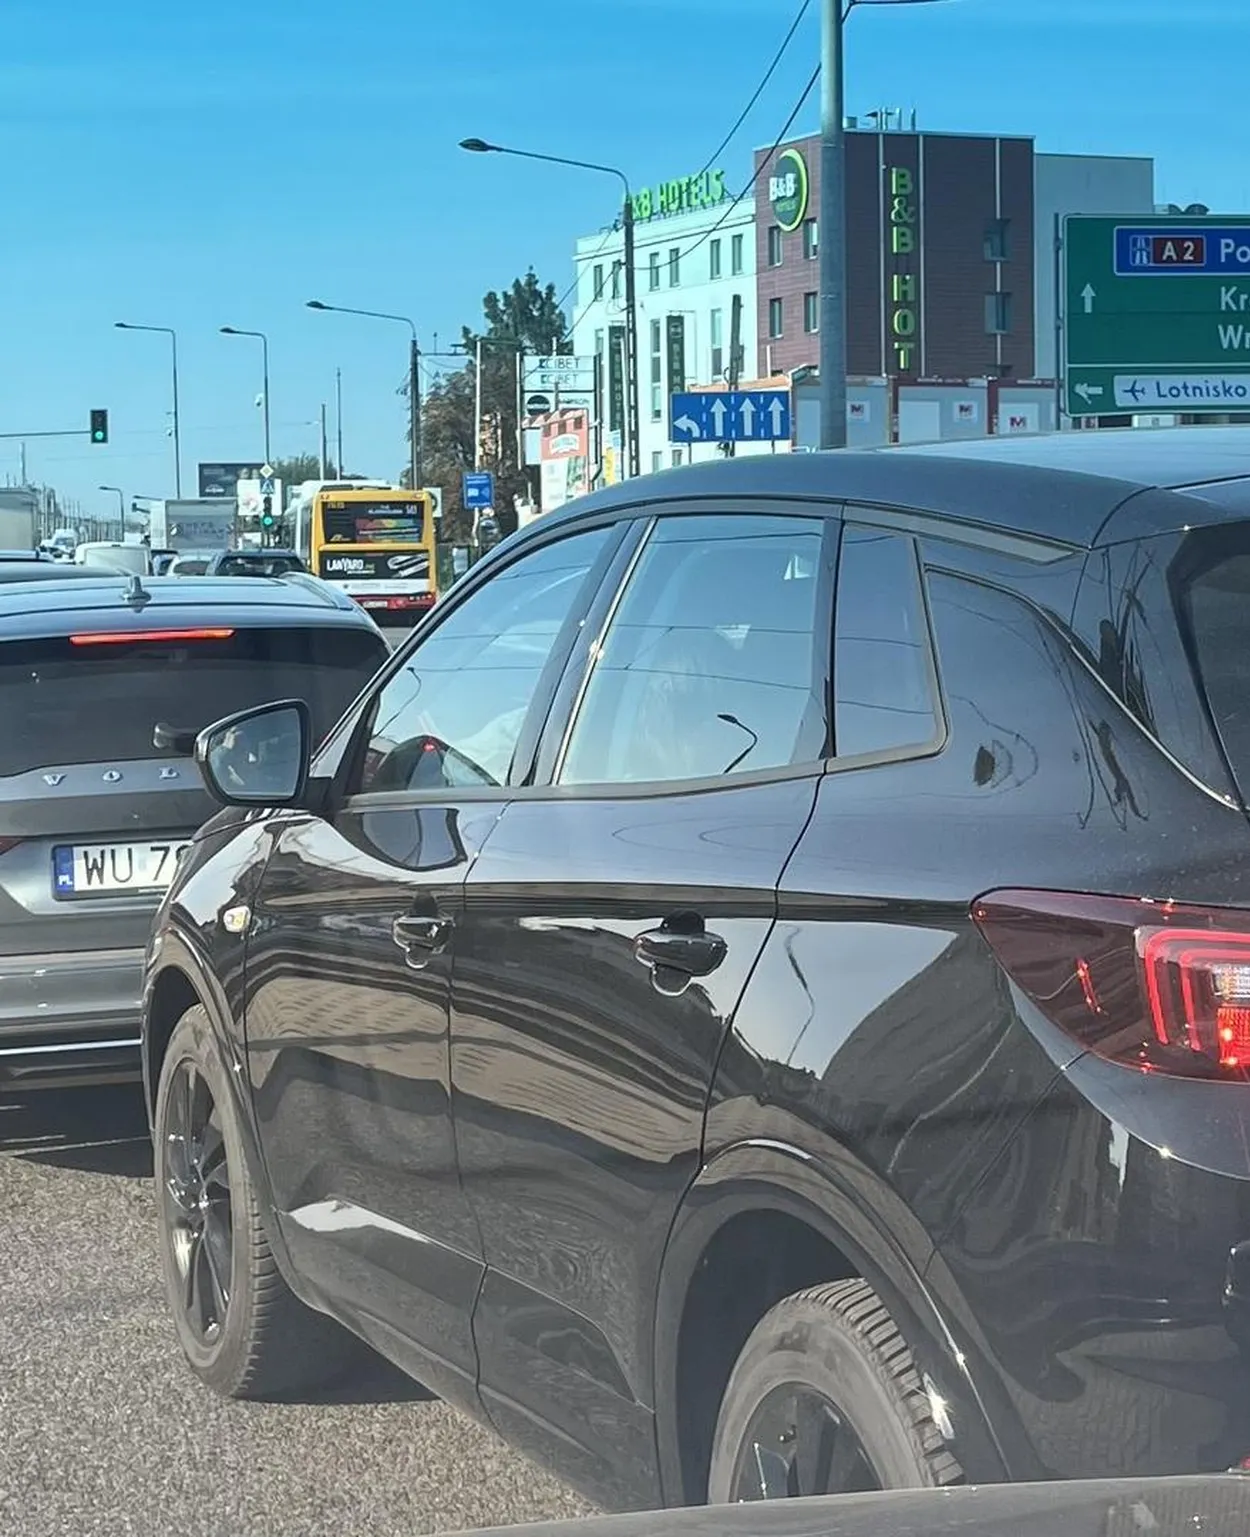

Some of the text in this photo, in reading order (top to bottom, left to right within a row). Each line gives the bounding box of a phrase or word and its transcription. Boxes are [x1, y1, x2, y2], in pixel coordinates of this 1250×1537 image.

[626, 170, 725, 219] &B HOTELS
[769, 172, 797, 202] B&B
[890, 167, 916, 253] B&B
[1156, 380, 1247, 399] Lotnisko
[43, 767, 181, 787] VOL
[83, 848, 134, 885] WU
